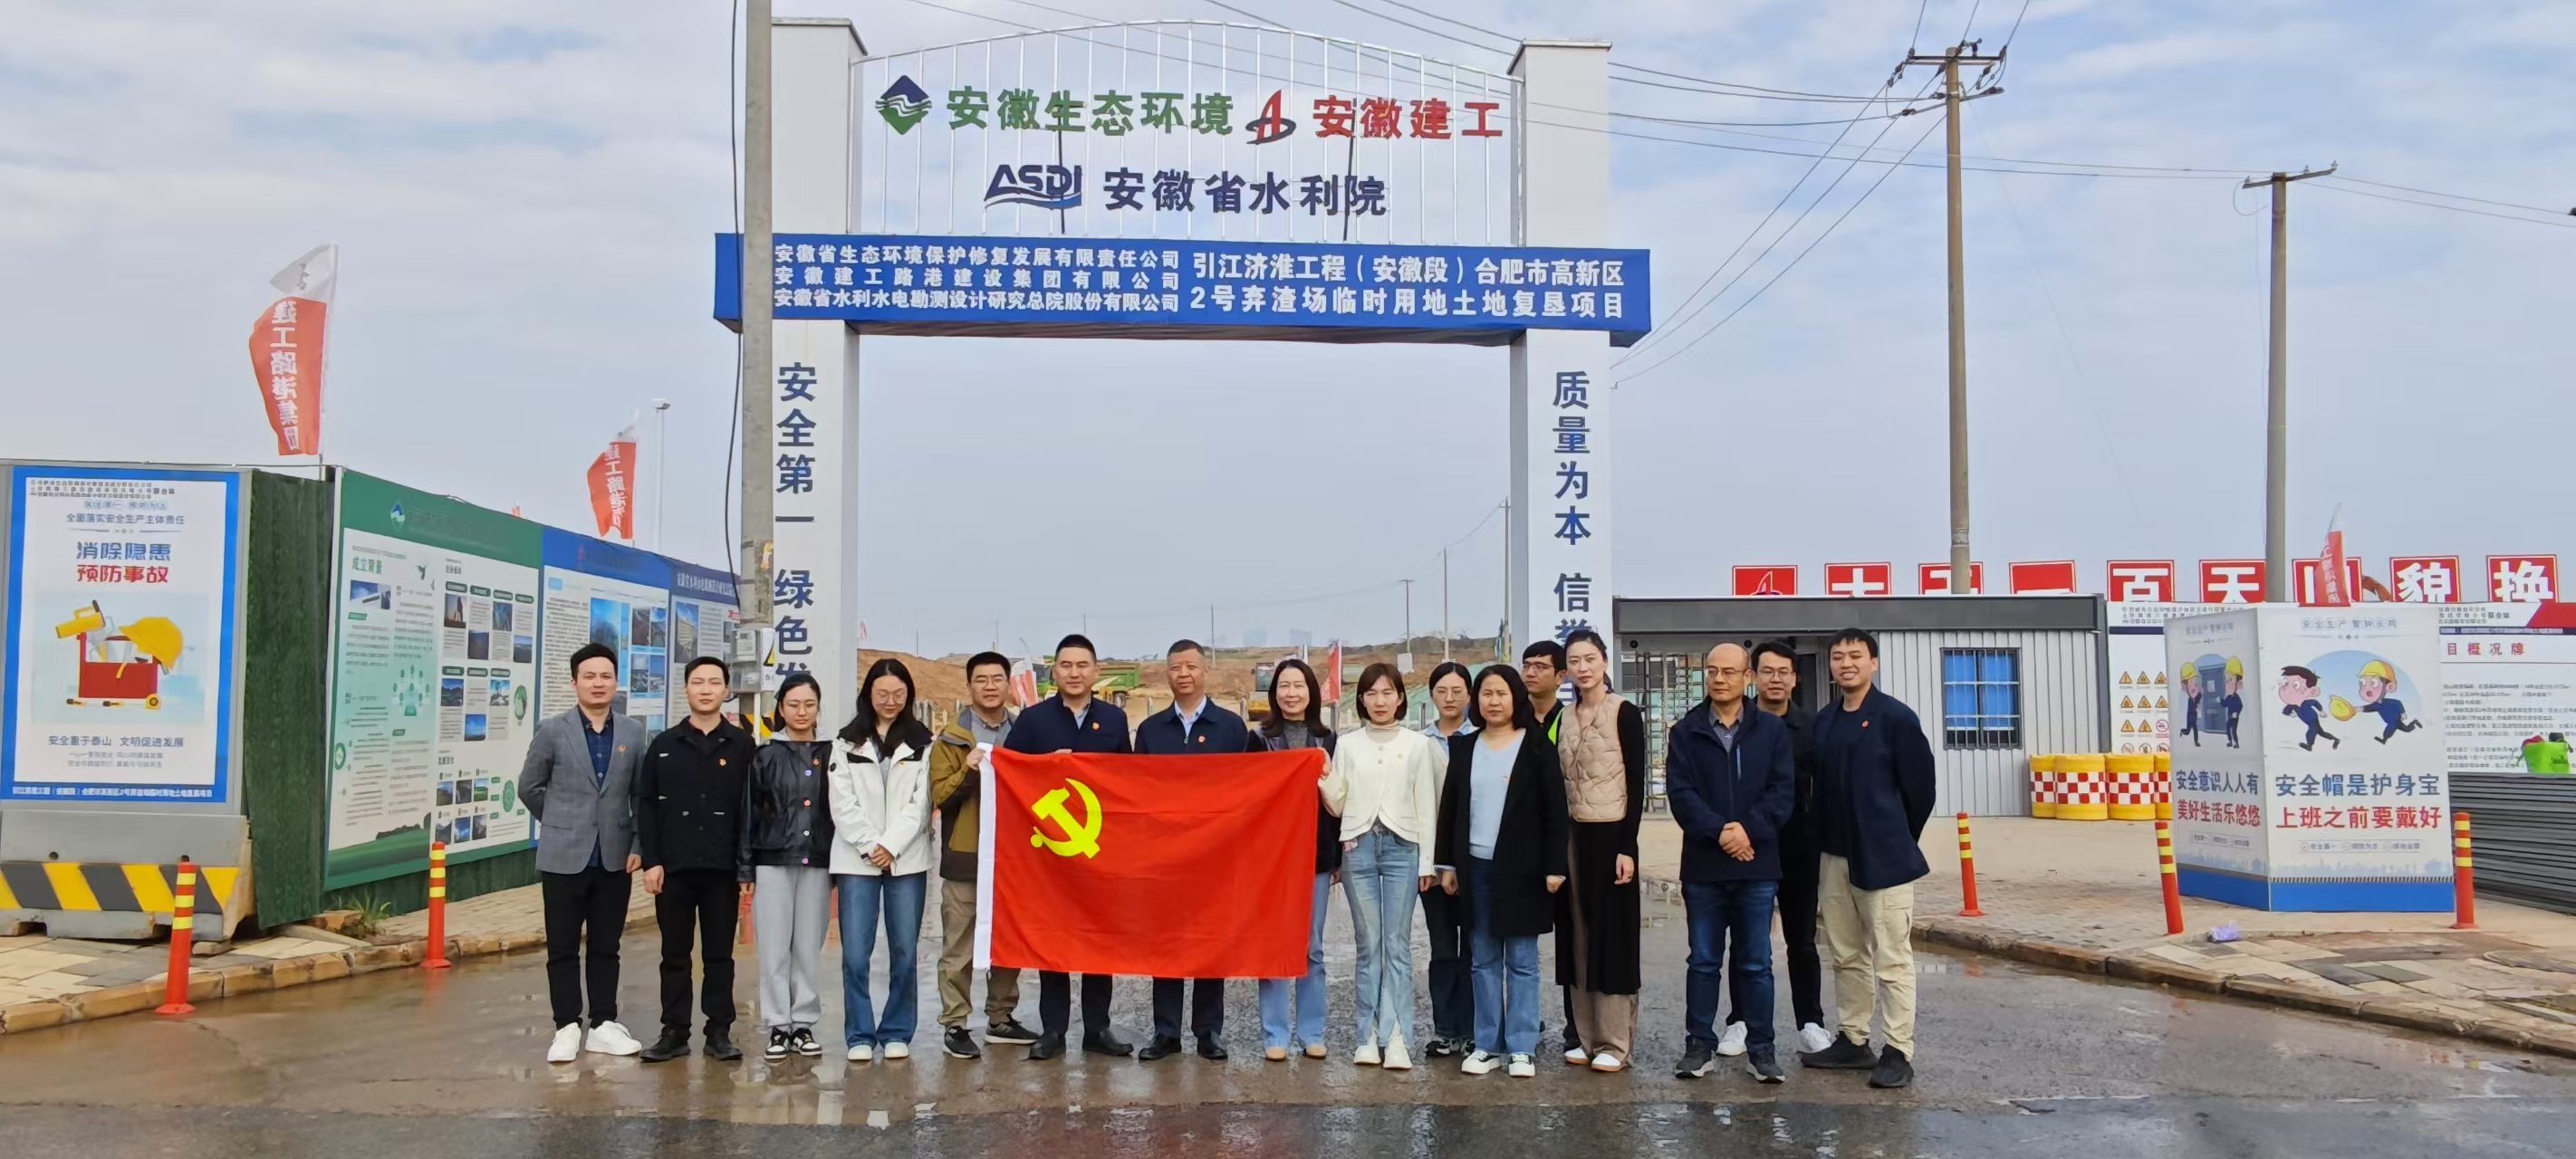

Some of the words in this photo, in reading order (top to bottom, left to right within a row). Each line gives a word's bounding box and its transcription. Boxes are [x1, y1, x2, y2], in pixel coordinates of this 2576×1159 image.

[946, 85, 1235, 137] 安徽生态环境
[1312, 94, 1504, 140] 安徽建工
[984, 164, 1082, 201] ASDI
[1103, 167, 1388, 216] 安徽省水利院
[774, 244, 1180, 270] 安徽省生态环境保护修复发展有限责任公司
[774, 268, 1180, 291] 安徽建工路港建设集团有限公司
[774, 289, 1180, 313] 安徽省水利水电勘测设计研究总院股份有限公司
[1189, 286, 1625, 319] 2号弃渣场临时用地土地复垦项目
[775, 361, 818, 522] 安全第一
[1552, 370, 1591, 545] 质量为本
[76, 541, 171, 561] 消除隐患
[76, 563, 169, 584] 预防事故
[2176, 770, 2259, 796] 安全意识人人有
[2274, 772, 2442, 798] 安全帽是护身宝
[2177, 799, 2262, 828] 美好生活乐悠悠
[2275, 805, 2443, 829] 上班之前要戴好
